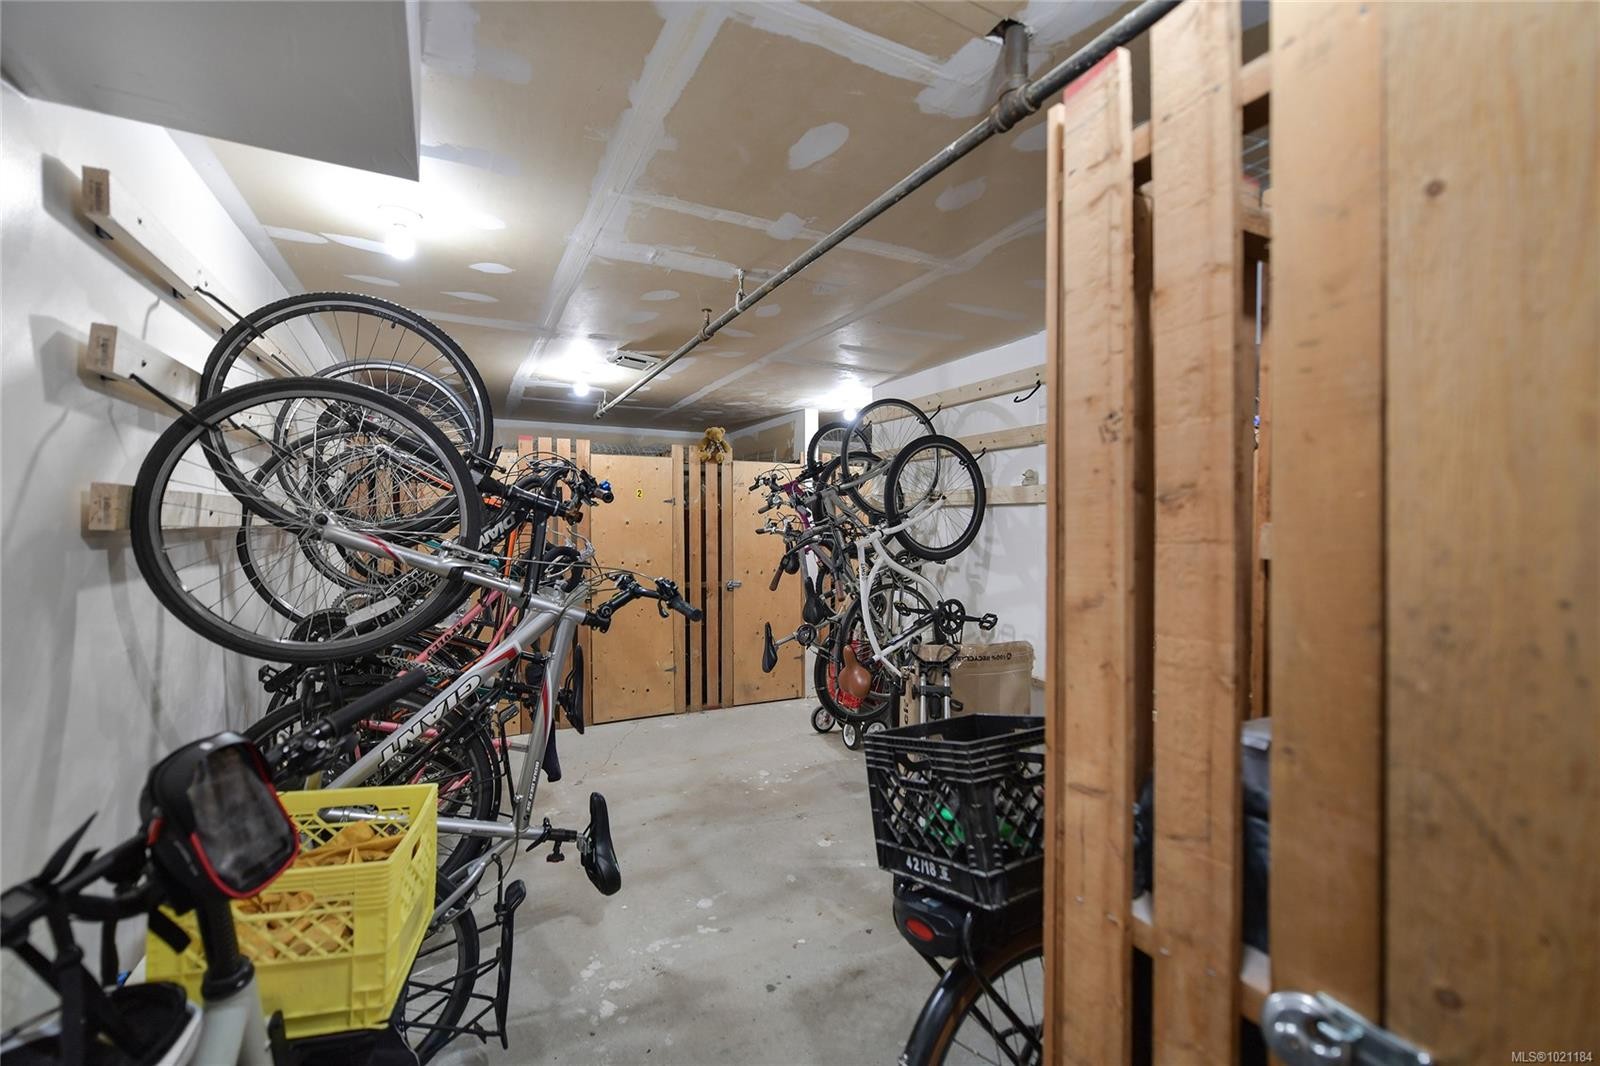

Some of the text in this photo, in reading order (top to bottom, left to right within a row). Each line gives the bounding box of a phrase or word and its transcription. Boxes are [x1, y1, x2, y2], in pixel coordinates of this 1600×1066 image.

[637, 489, 642, 498] 2
[427, 621, 464, 656] APOLLO
[378, 675, 481, 771] GIANT
